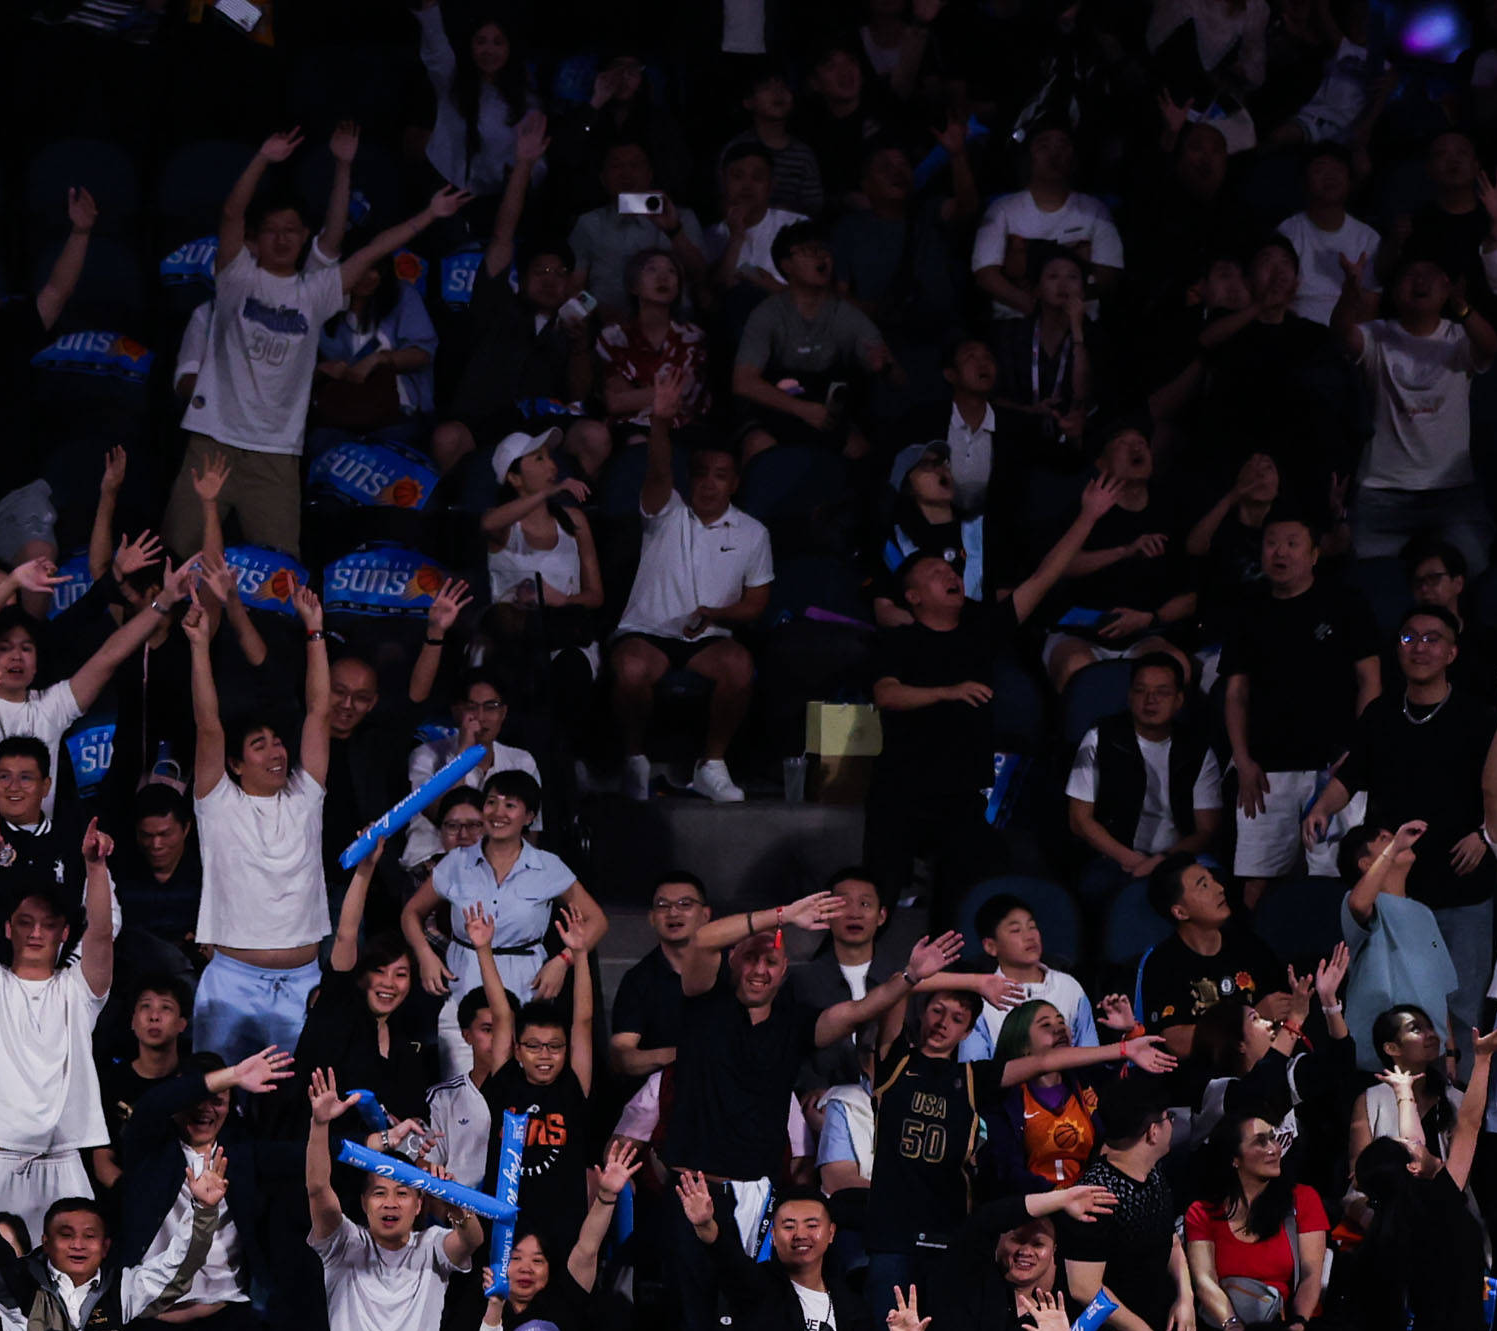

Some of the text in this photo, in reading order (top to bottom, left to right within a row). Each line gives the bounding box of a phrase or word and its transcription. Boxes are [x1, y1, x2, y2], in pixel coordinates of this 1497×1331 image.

[330, 564, 408, 600] SUNS
[910, 1091, 947, 1120] USA
[899, 1118, 947, 1164] 50
